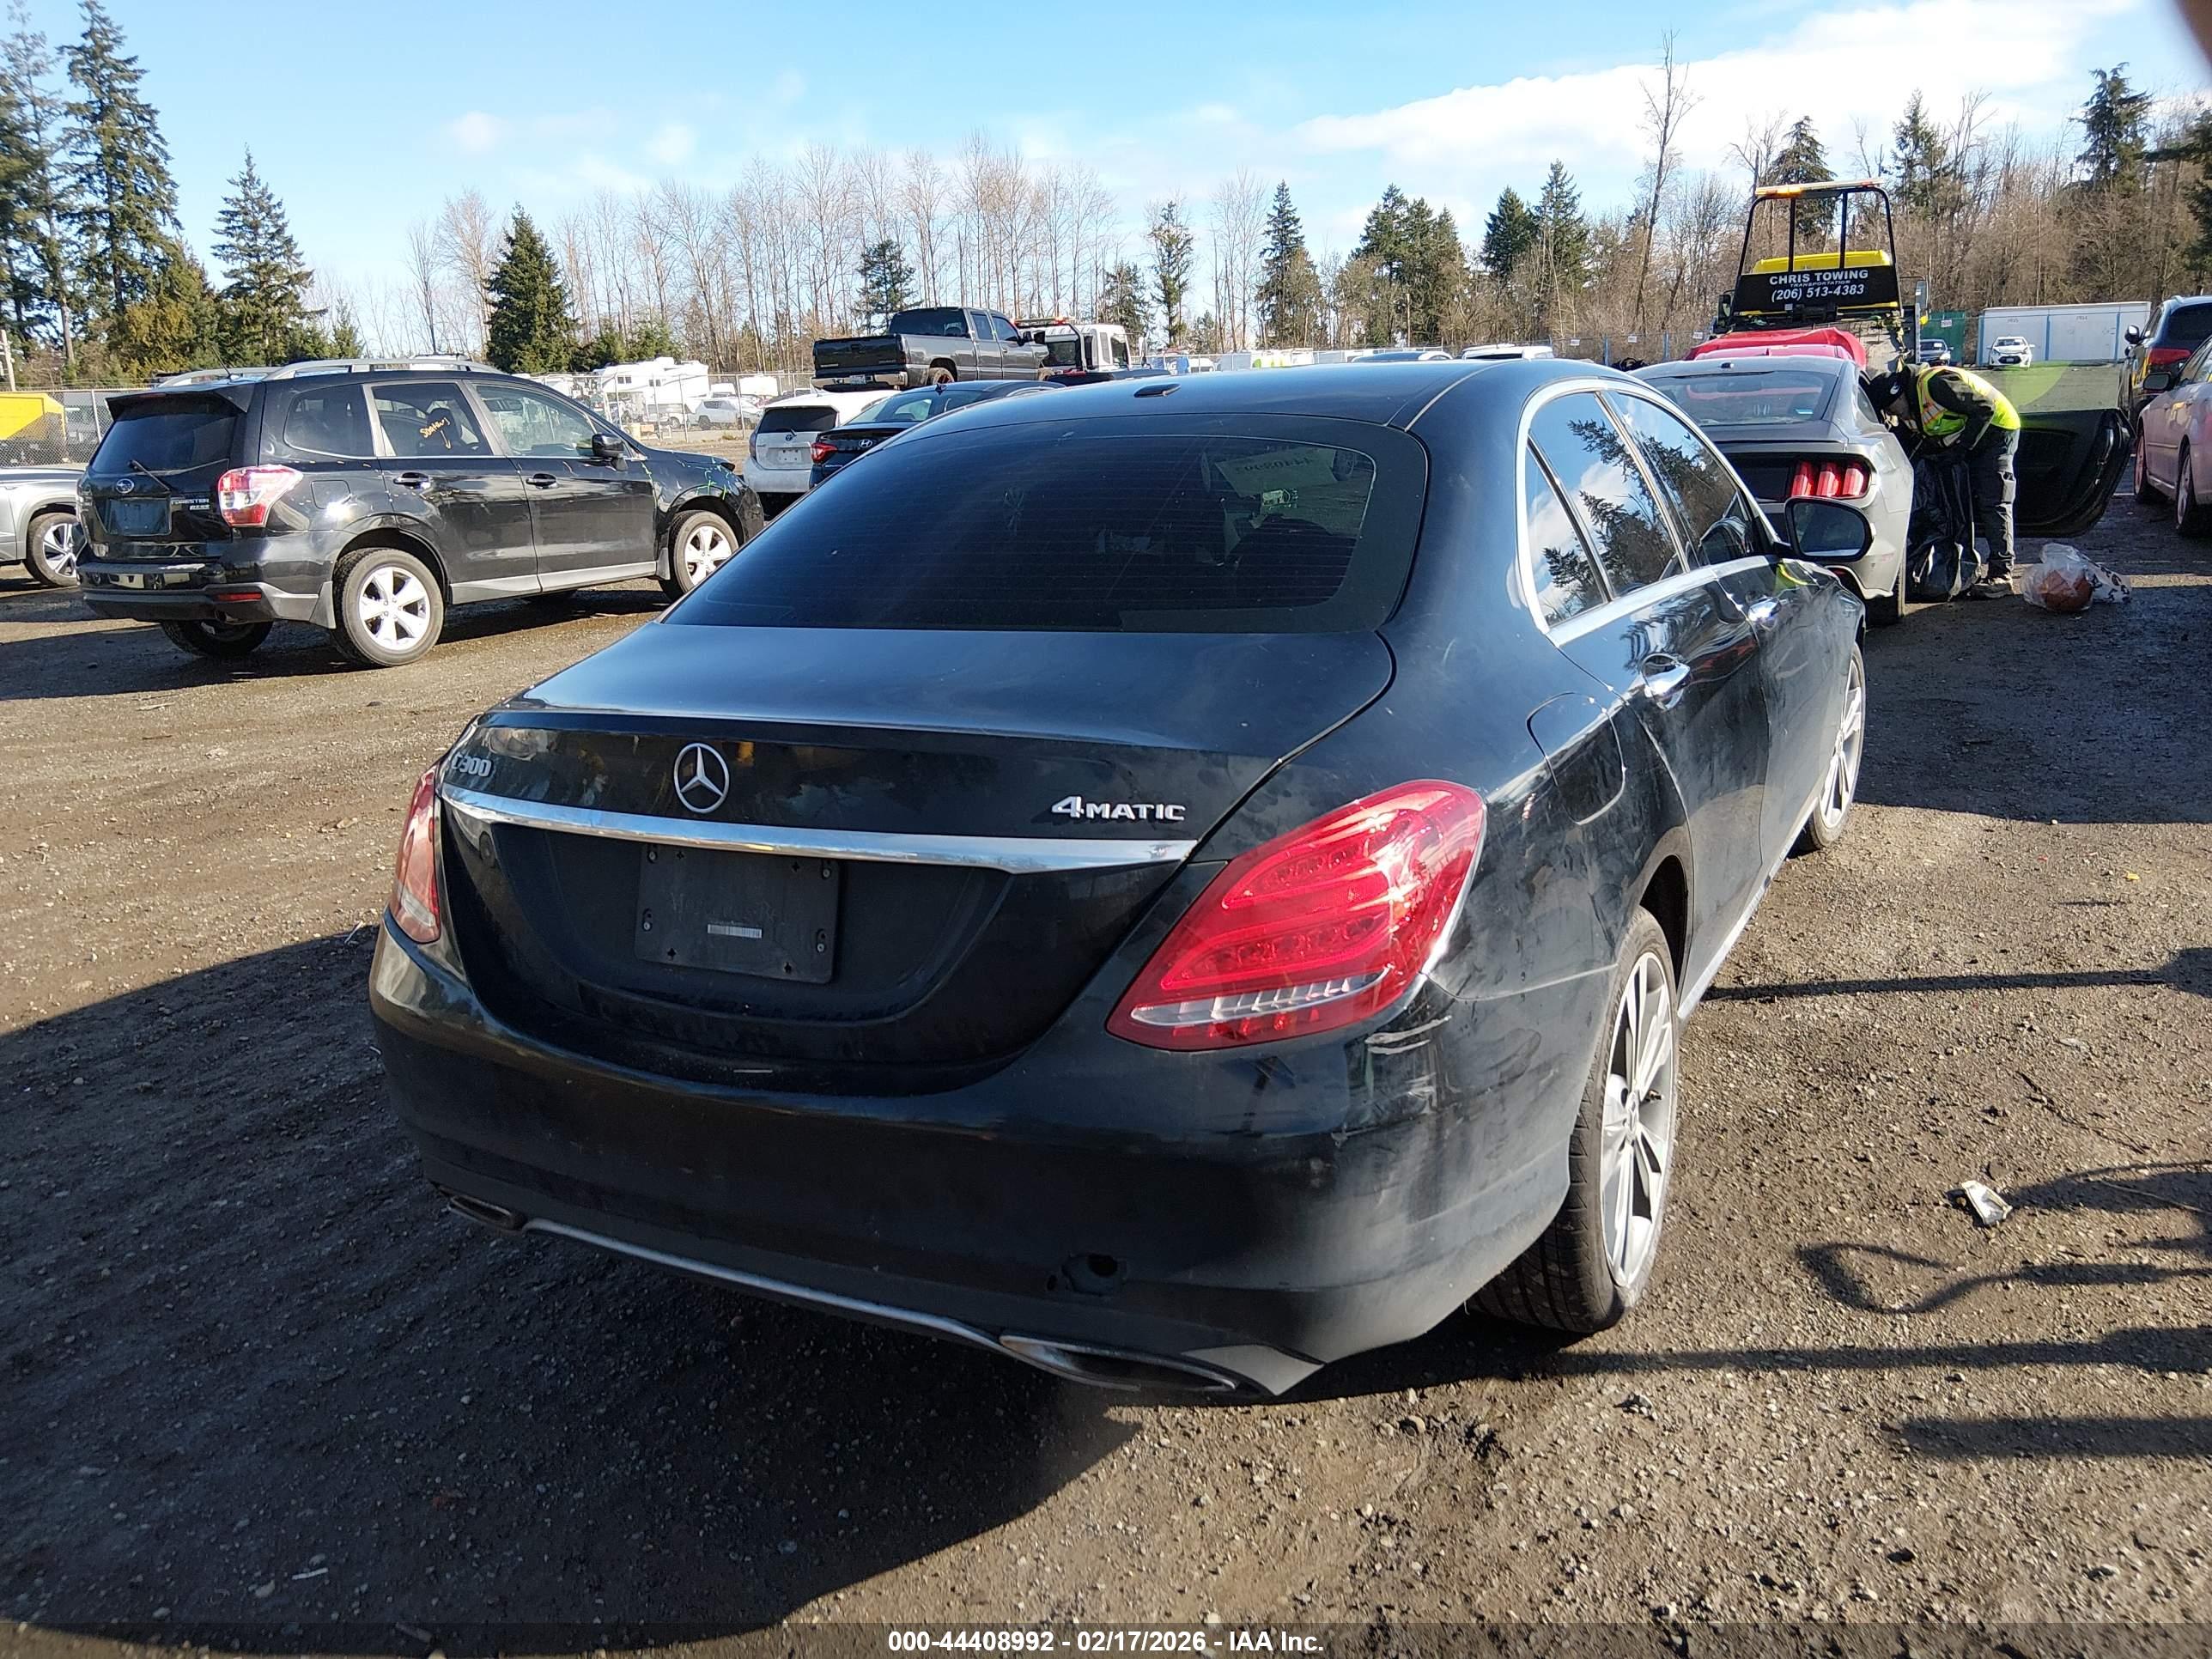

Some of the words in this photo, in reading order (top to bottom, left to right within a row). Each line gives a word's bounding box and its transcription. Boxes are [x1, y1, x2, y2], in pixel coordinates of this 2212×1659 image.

[1769, 273, 1810, 285] CHRIS
[1814, 270, 1869, 282] TOWING
[1771, 288, 1802, 303] (206)
[1806, 283, 1864, 298] 513-4383
[452, 752, 492, 776] C300
[1051, 796, 1186, 820] 4MATIC
